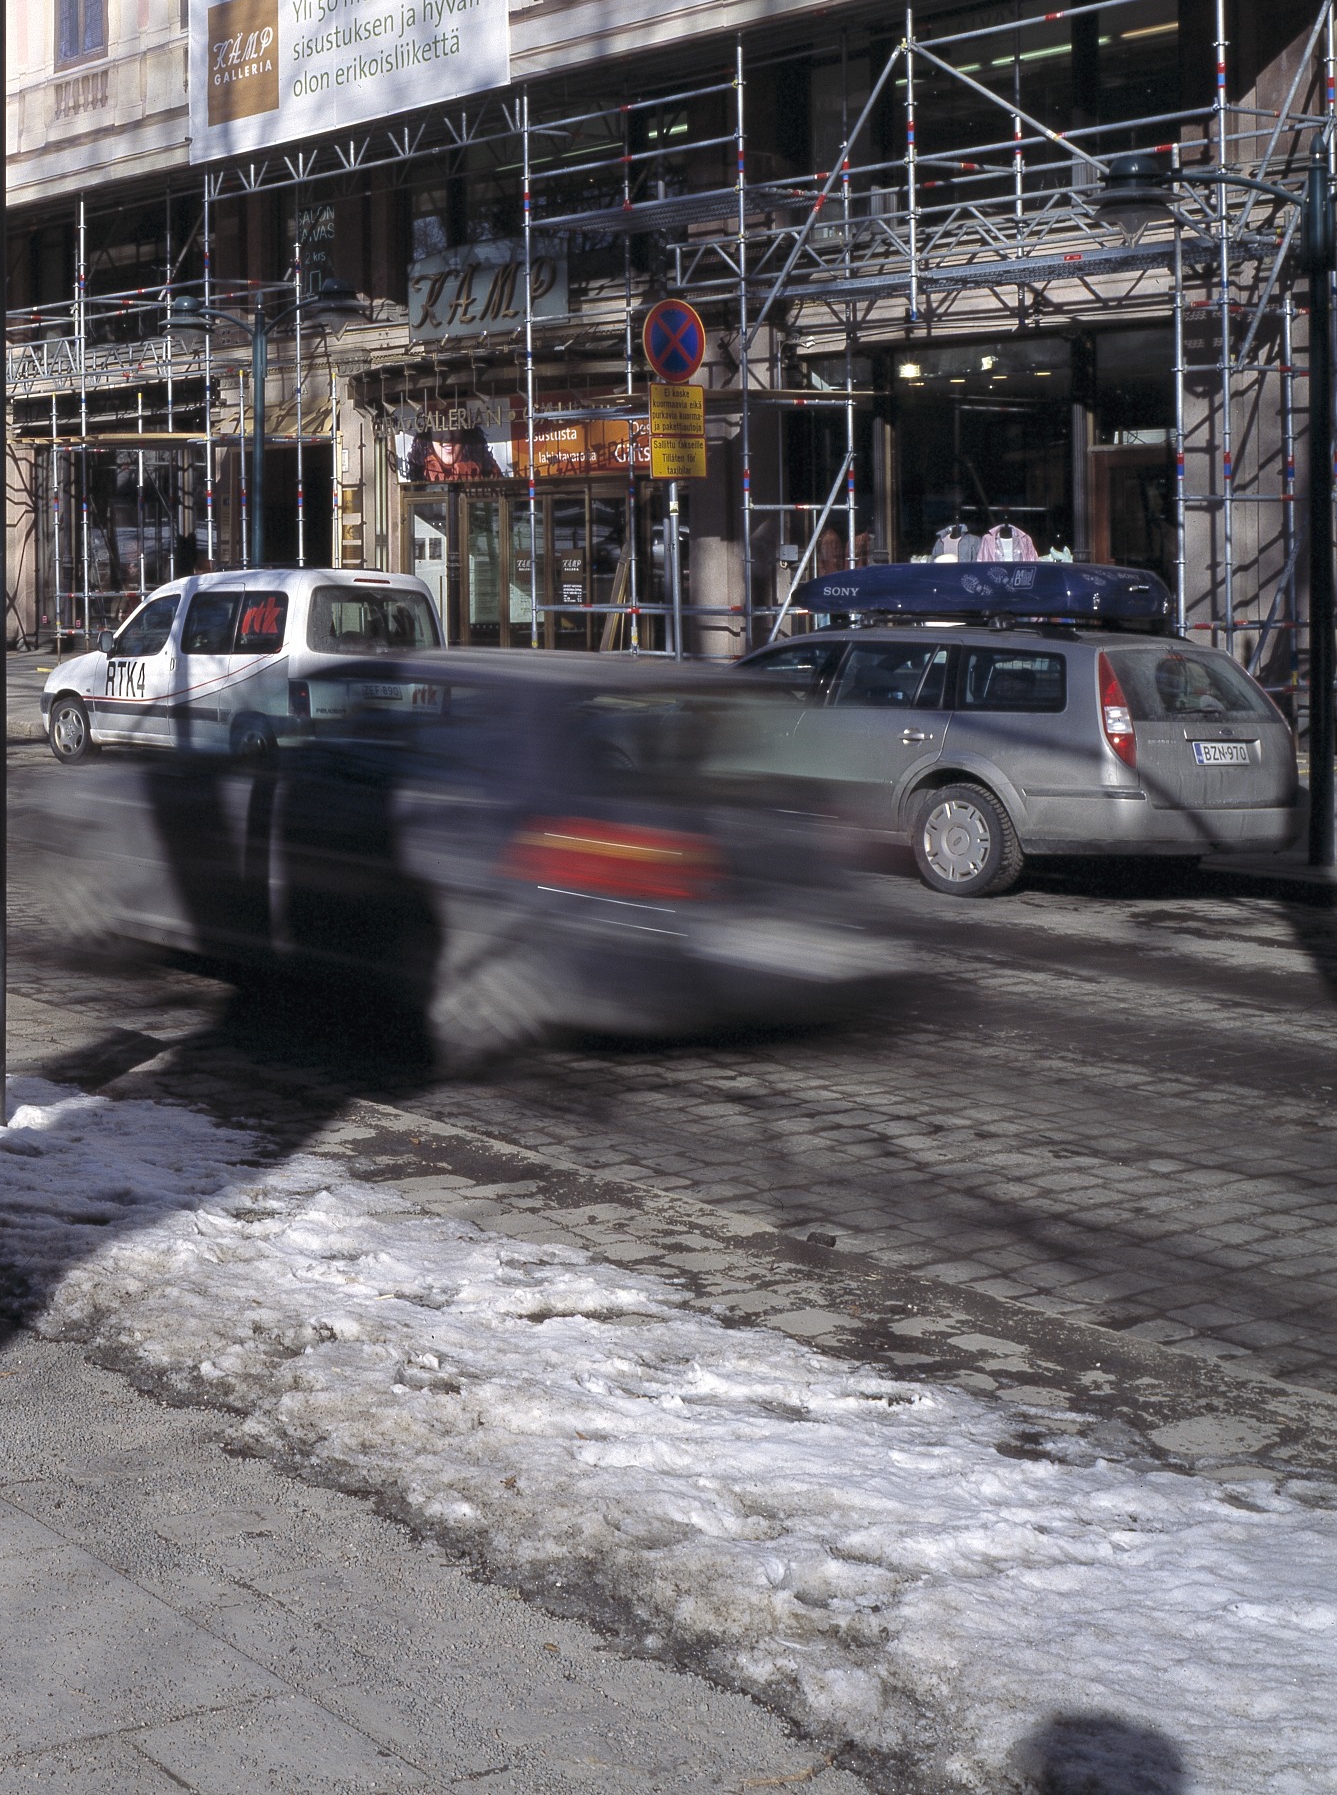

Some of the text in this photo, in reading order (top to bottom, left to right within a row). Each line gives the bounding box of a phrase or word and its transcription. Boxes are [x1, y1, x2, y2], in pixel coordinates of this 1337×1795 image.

[292, 13, 395, 62] sisustuksen
[397, 4, 416, 38] ja
[213, 25, 274, 72] KÄMP
[292, 28, 461, 98] olon erikoisliikettä
[214, 58, 273, 86] GALLERIA
[664, 388, 690, 398] Ei koske
[652, 399, 702, 410] kuormaavia eikä
[414, 405, 502, 434] GALLERIAN
[652, 411, 677, 420] purkavia
[654, 421, 702, 433] ja pakettiautoja
[525, 427, 577, 443] ssustusta
[653, 440, 704, 450] Sallittu takseille
[662, 452, 696, 463] Tillåten för
[667, 466, 692, 476] taxibilar
[823, 586, 860, 597] SONY
[105, 660, 146, 698] RTK4
[1204, 746, 1248, 761] BZN-970
